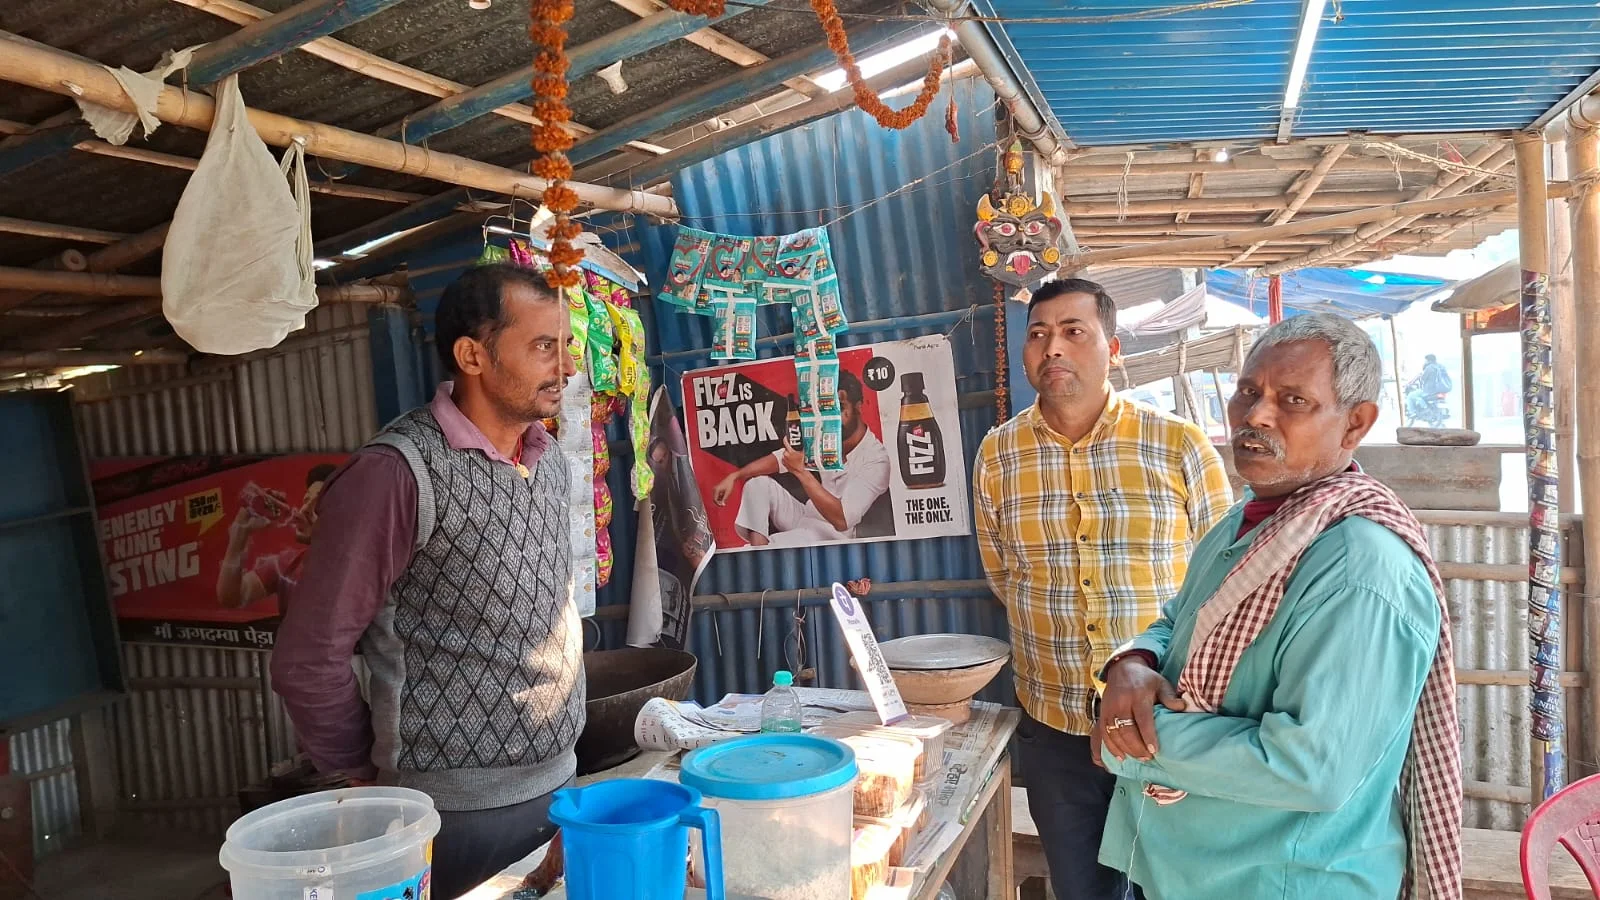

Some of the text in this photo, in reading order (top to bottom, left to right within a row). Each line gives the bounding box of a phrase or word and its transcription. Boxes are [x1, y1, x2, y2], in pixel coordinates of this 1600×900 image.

[692, 373, 739, 407] FIZZ
[739, 382, 754, 401] IS
[696, 401, 780, 448] BACK
[788, 425, 802, 446] FIZZ
[906, 431, 936, 475] FIZZ
[102, 500, 177, 540] ENERGY
[905, 497, 950, 510] THE ONE.
[905, 509, 953, 524] THE ONLY.
[109, 541, 200, 597] STING
